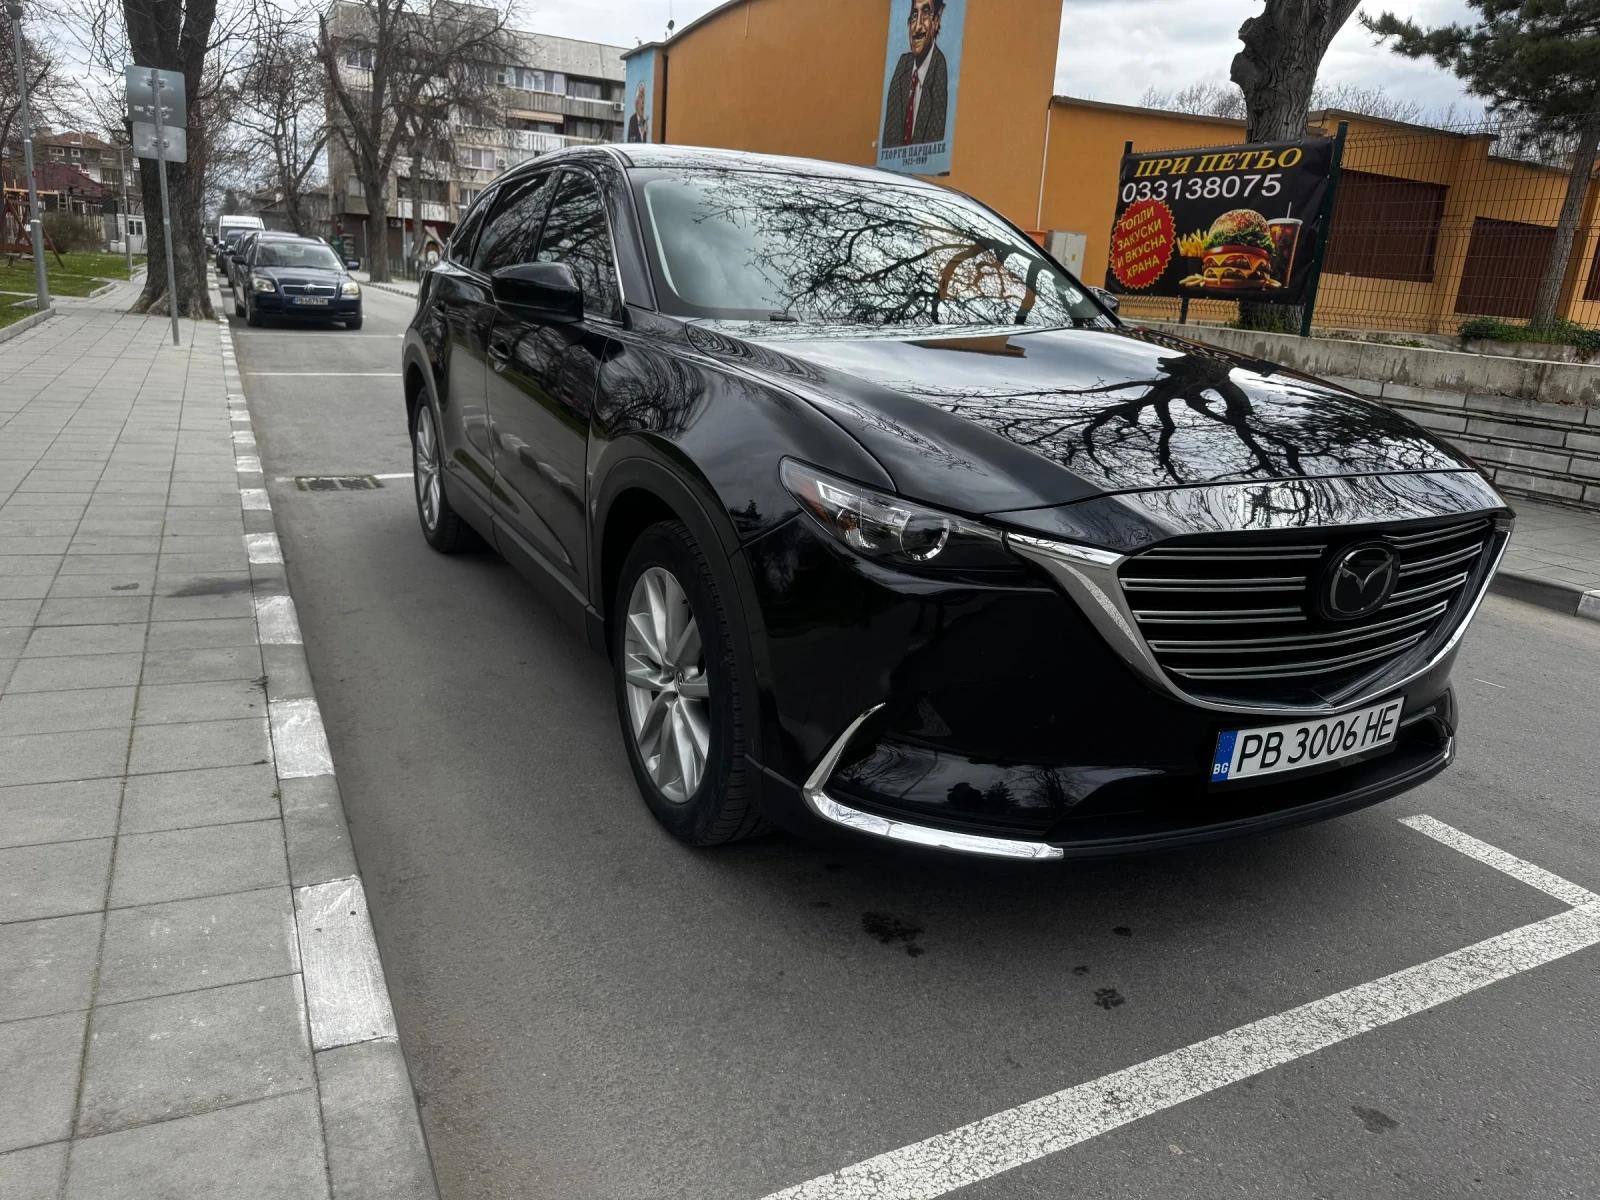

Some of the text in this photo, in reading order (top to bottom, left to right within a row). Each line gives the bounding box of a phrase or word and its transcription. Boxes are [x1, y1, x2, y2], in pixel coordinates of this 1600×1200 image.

[1133, 147, 1303, 178] ПРИ ПЕТЬО
[1122, 174, 1282, 203] 033138075
[1117, 218, 1162, 251] ЗАКУСКИ
[1120, 206, 1154, 233] ТОПЛИ
[1117, 234, 1167, 268] И ВКУСНА
[1126, 254, 1160, 280] ХРАНА
[1236, 703, 1399, 773] PB 3006 HE
[1213, 763, 1229, 775] BG
